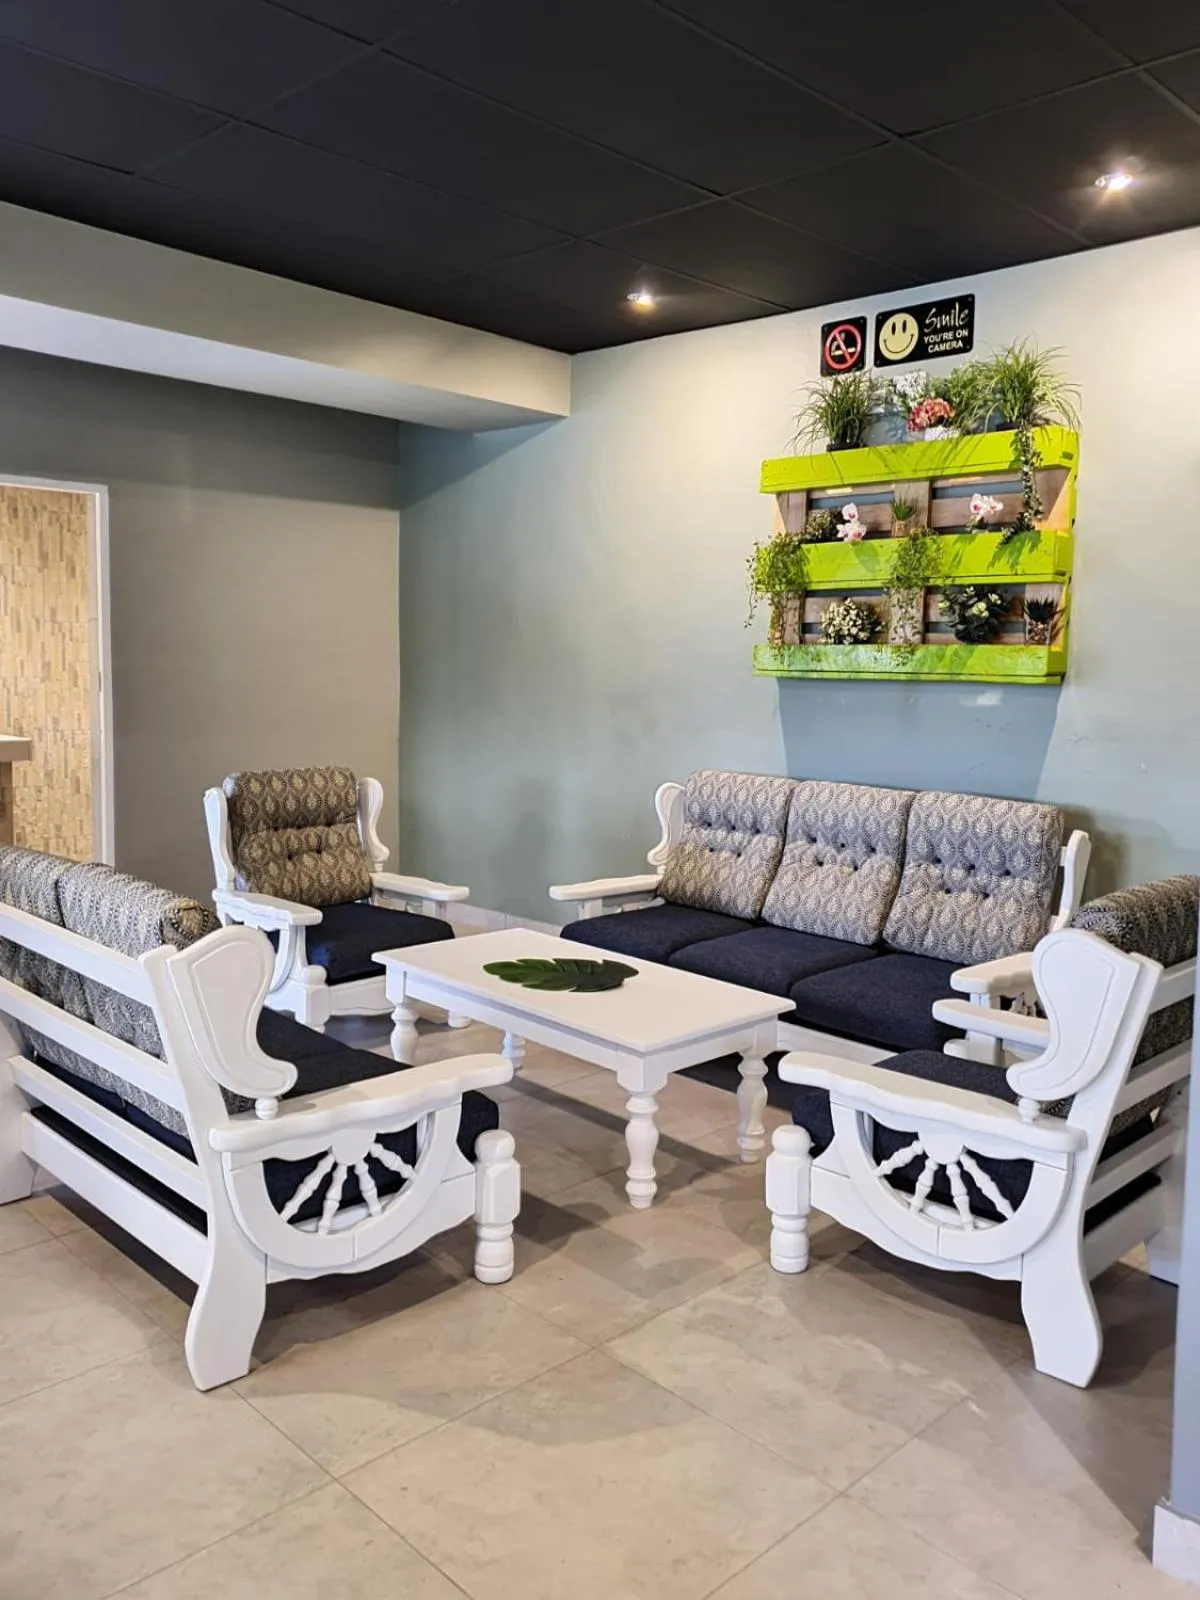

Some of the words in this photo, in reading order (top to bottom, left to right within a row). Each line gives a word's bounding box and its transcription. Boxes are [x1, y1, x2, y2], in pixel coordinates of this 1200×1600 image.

[924, 302, 968, 332] Smile
[924, 331, 954, 344] YOU'RE
[955, 328, 968, 338] ON
[928, 340, 963, 353] CAMERA
